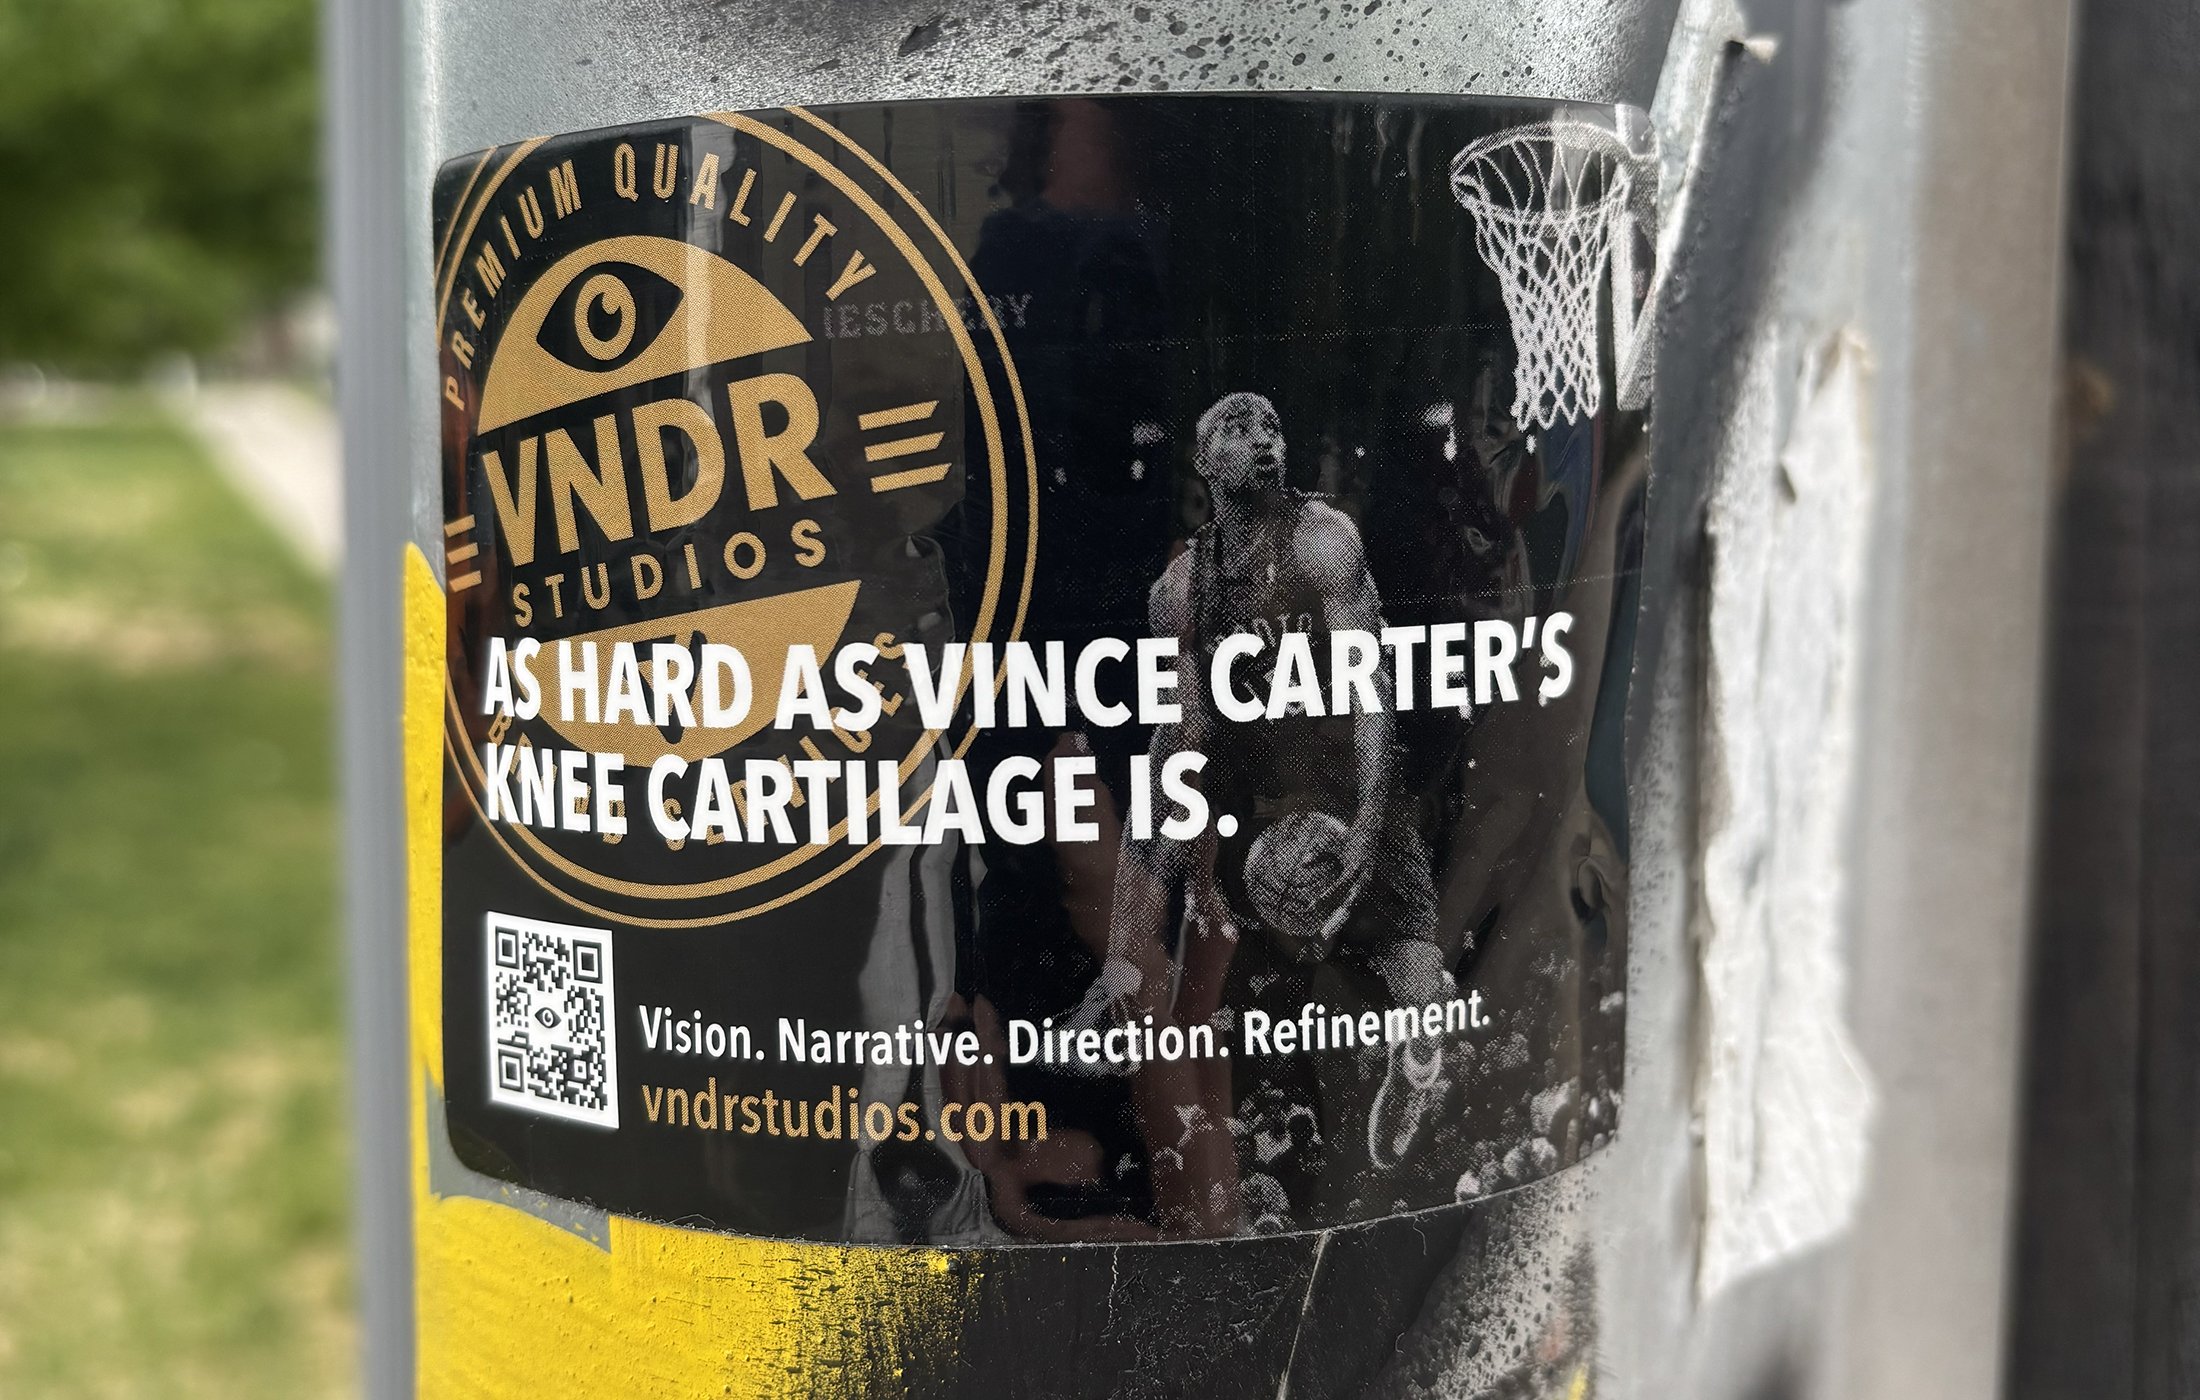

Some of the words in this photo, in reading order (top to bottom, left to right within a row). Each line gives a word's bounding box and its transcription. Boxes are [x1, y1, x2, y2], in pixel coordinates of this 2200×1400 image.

[443, 159, 582, 412] PREMIUM
[614, 142, 878, 300] QUALITY
[482, 372, 838, 567] VNDR
[512, 518, 827, 628] STUDIOS
[483, 636, 542, 722] AS
[558, 640, 754, 729] HARD
[773, 641, 883, 733] AS
[901, 635, 1184, 730] VINCE
[1209, 610, 1574, 724] CARTER'S
[485, 741, 629, 839] KNEE
[647, 752, 1099, 845] CARTILAGE
[1130, 749, 1239, 842] IS.
[639, 1005, 765, 1062] Vision.
[778, 1016, 993, 1067] Narrative.
[1009, 1014, 1229, 1065] Direction.
[1244, 988, 1491, 1056] Refinement.
[641, 1076, 1048, 1142] vndrstudios.com
